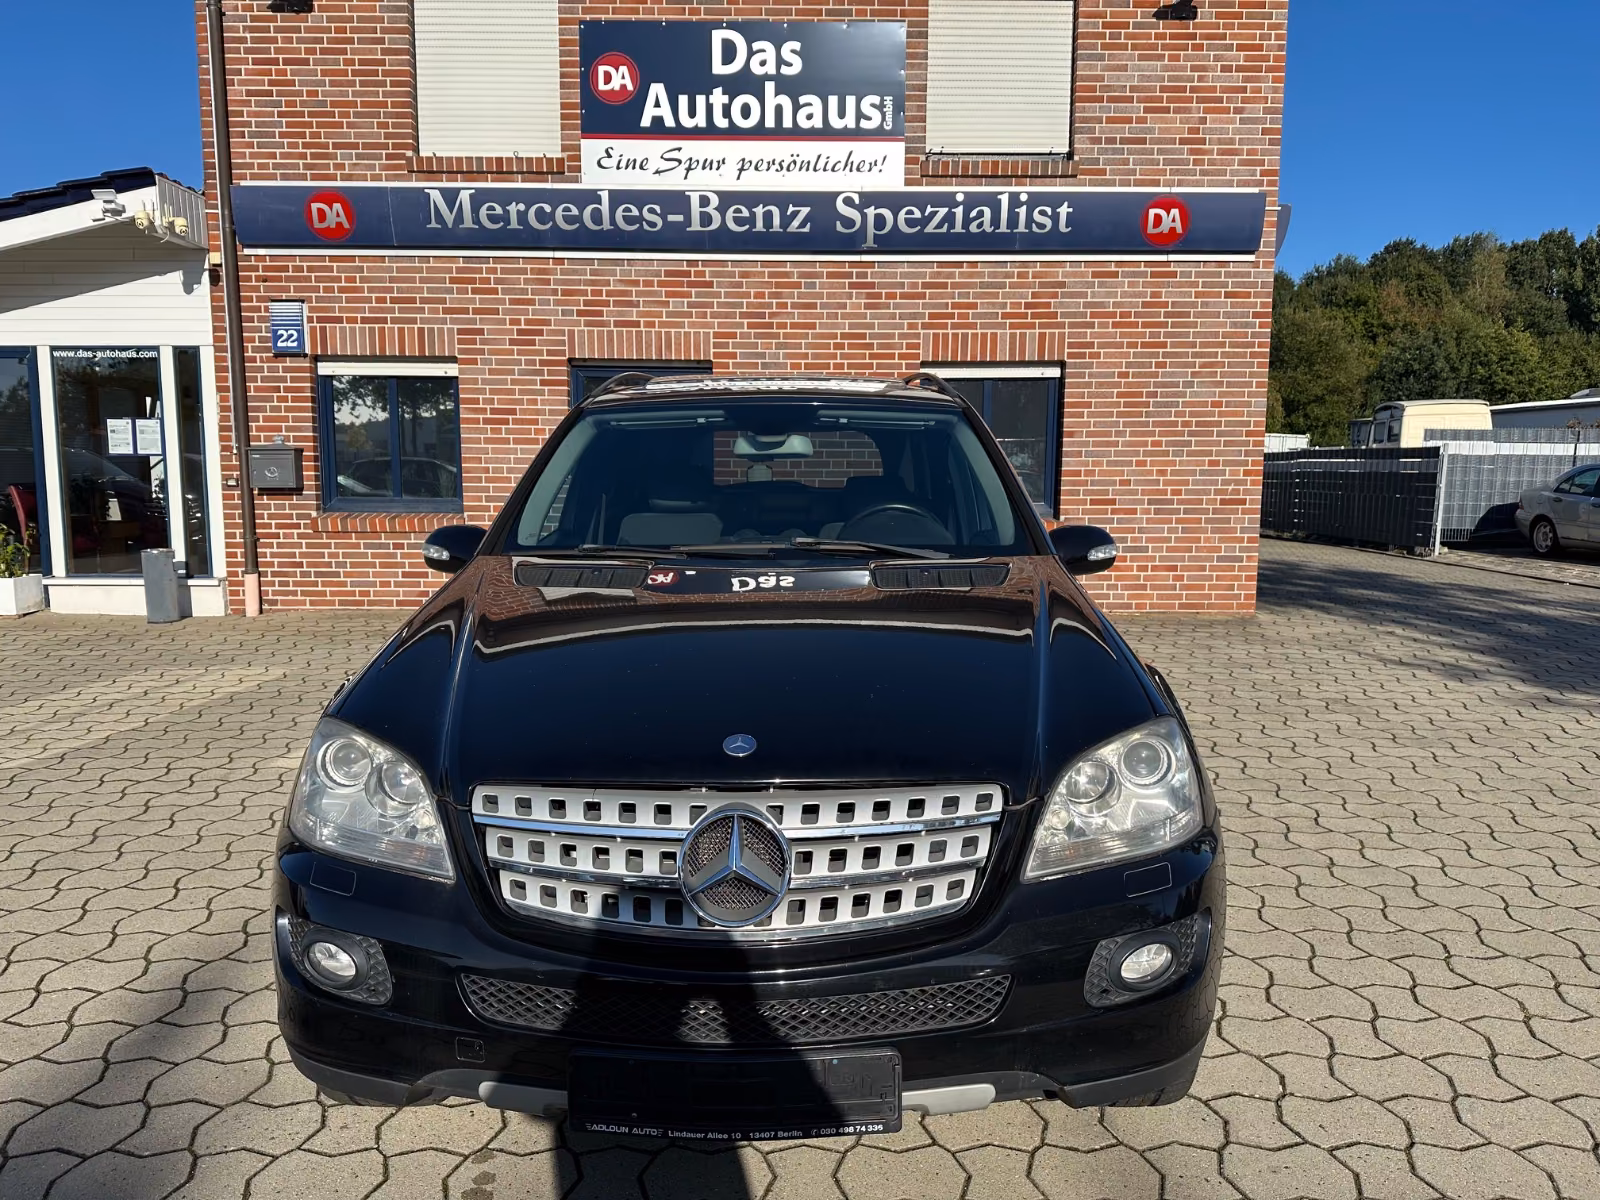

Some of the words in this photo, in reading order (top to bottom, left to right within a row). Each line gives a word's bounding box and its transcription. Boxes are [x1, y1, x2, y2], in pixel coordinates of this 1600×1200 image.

[711, 28, 803, 76] Das
[598, 65, 634, 92] DA
[639, 81, 882, 130] Autohaus
[883, 96, 894, 130] GmbH
[596, 146, 649, 171] Eine
[652, 147, 726, 181] Spur
[736, 150, 887, 181] persönlicher!
[310, 202, 350, 230] DA
[424, 188, 811, 233] Mercedes-Benz
[835, 190, 1073, 248] Spezialist
[1146, 207, 1183, 234] DA
[276, 329, 299, 347] 22
[52, 348, 158, 358] www.das-autohaus.com
[591, 1123, 629, 1134] ADLOUN
[631, 1127, 658, 1136] AUTO
[668, 1130, 705, 1139] Lindauer
[707, 1131, 728, 1139] Allee
[749, 1131, 775, 1139] 13407
[778, 1130, 803, 1138] Berlin
[820, 1127, 836, 1135] 030
[838, 1125, 854, 1134] 498
[855, 1125, 867, 1133] 74
